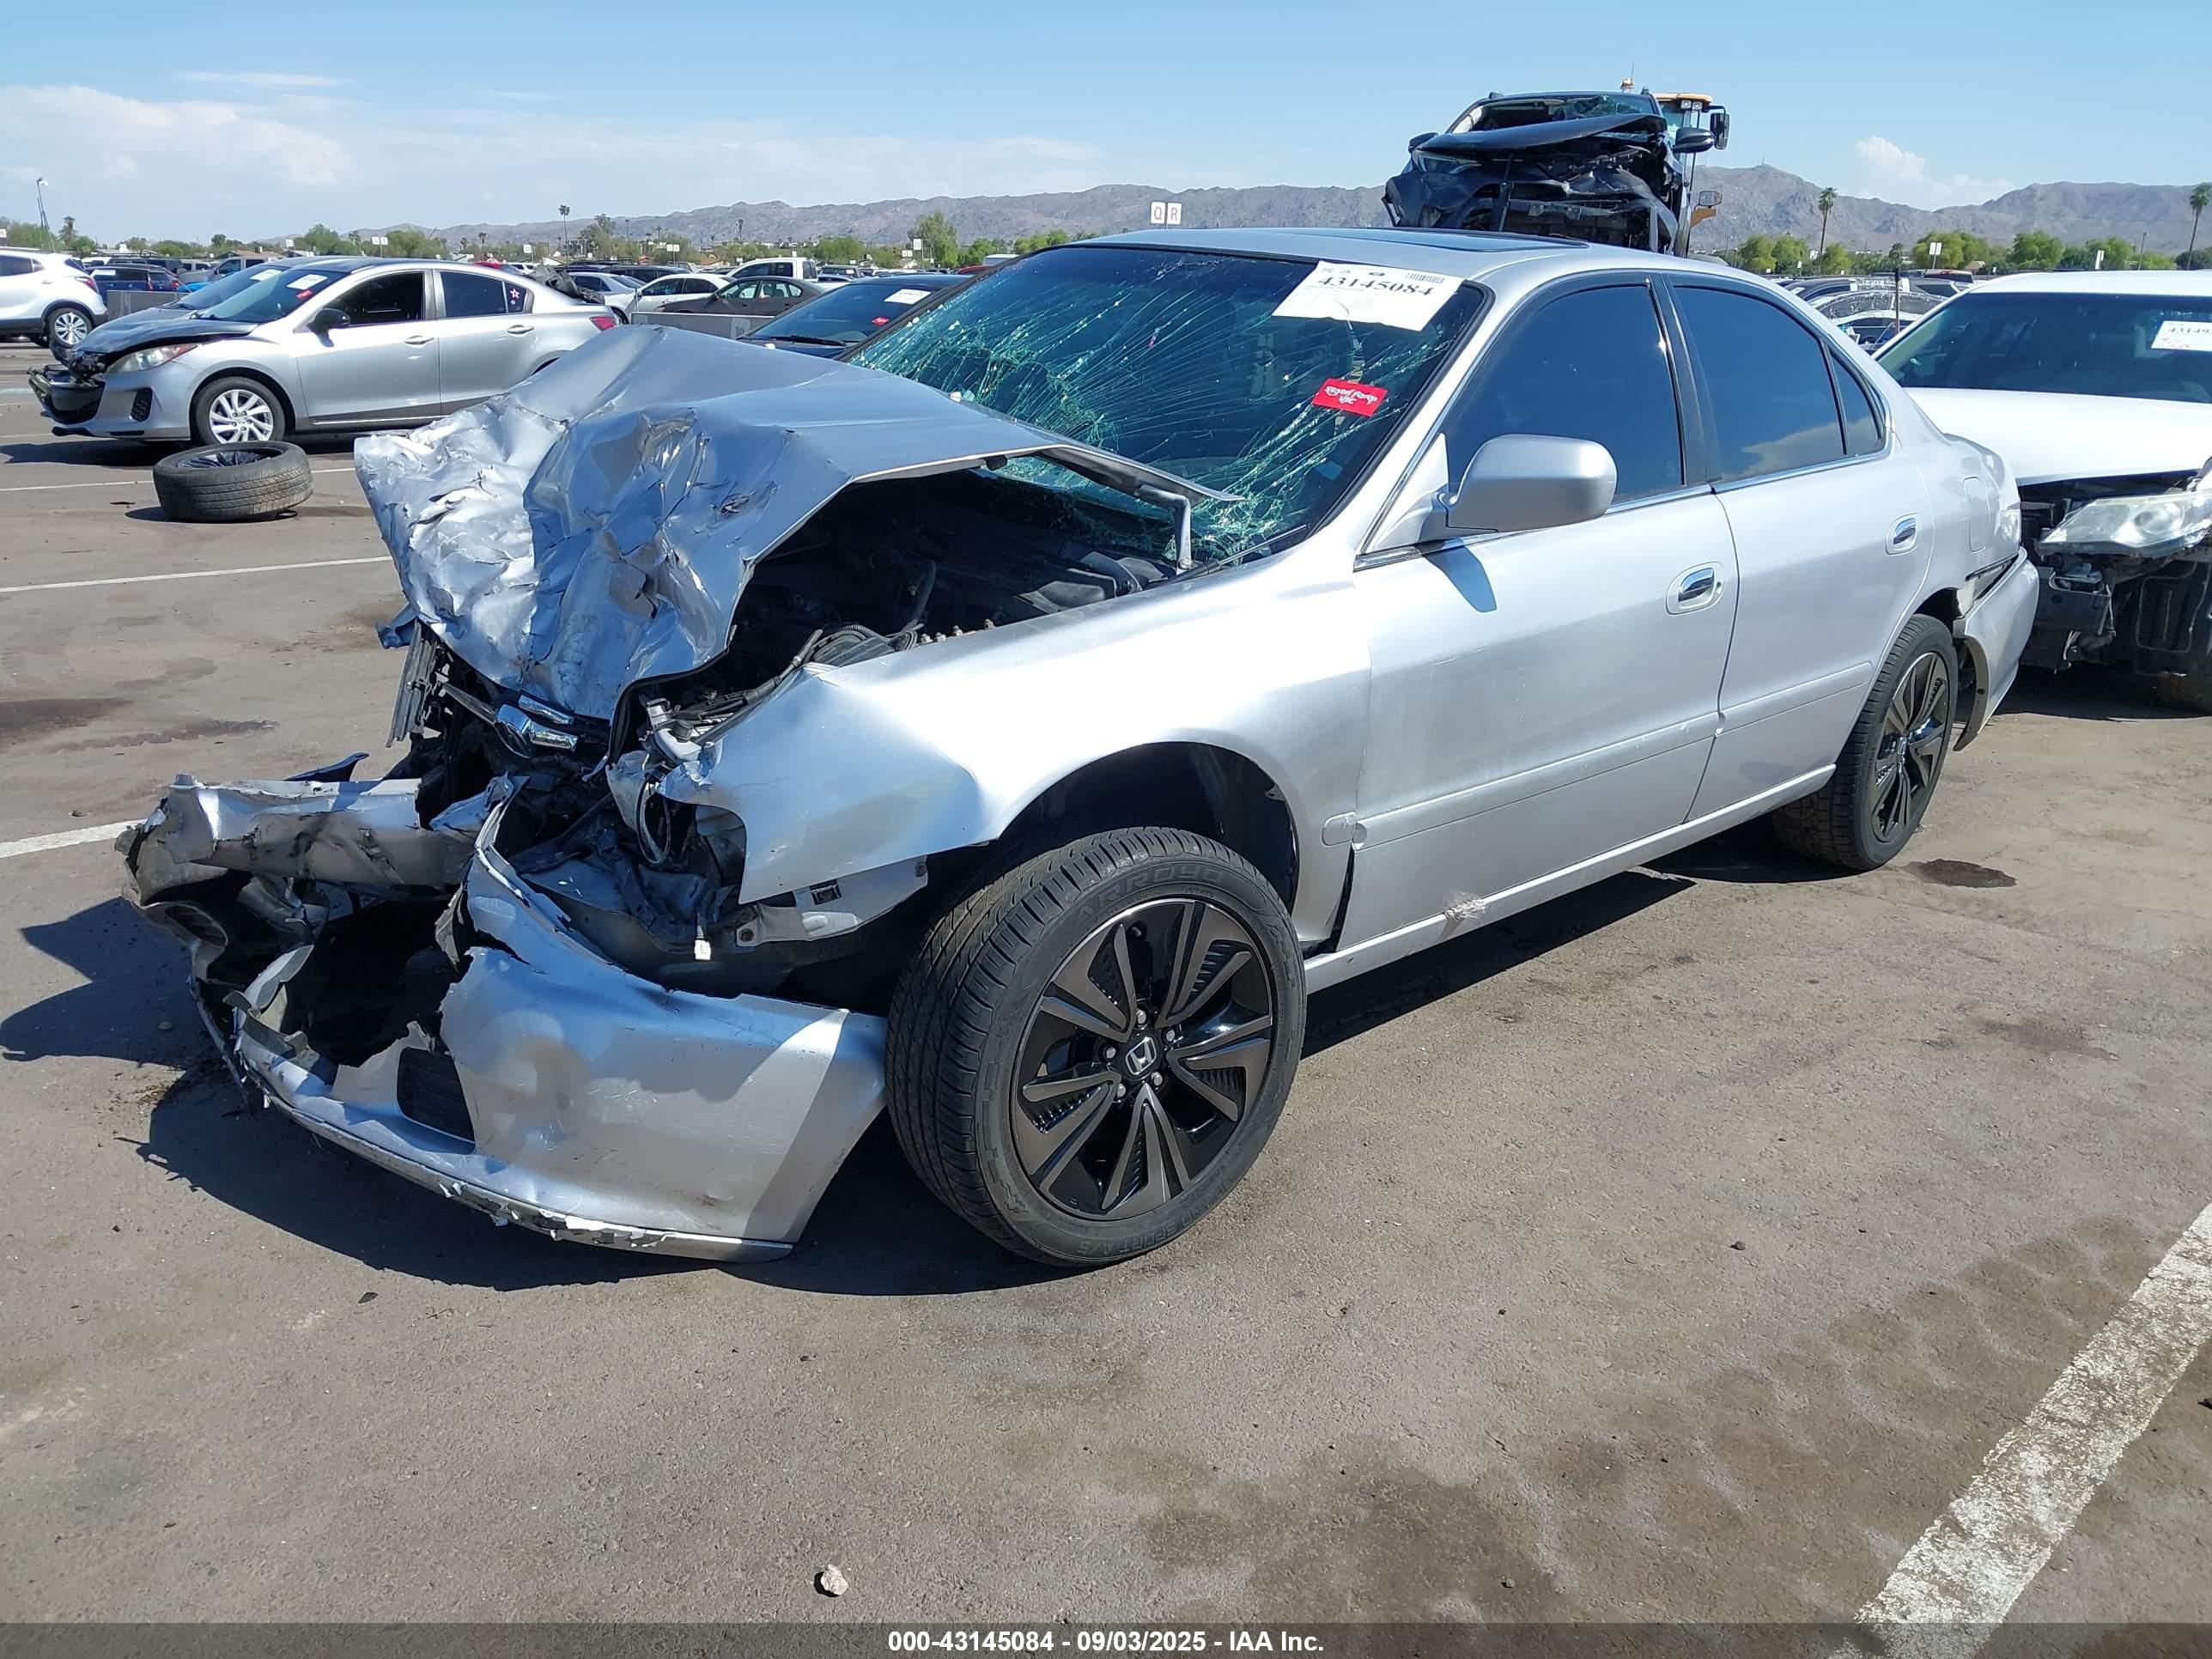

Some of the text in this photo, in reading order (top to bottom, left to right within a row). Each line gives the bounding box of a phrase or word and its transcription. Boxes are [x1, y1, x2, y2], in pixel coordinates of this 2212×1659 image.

[1154, 206, 1163, 221] Q
[1170, 207, 1178, 221] R
[1317, 276, 1434, 296] 43145084
[1077, 864, 1224, 923] ARROYO
[1119, 1223, 1177, 1254] SPORT
